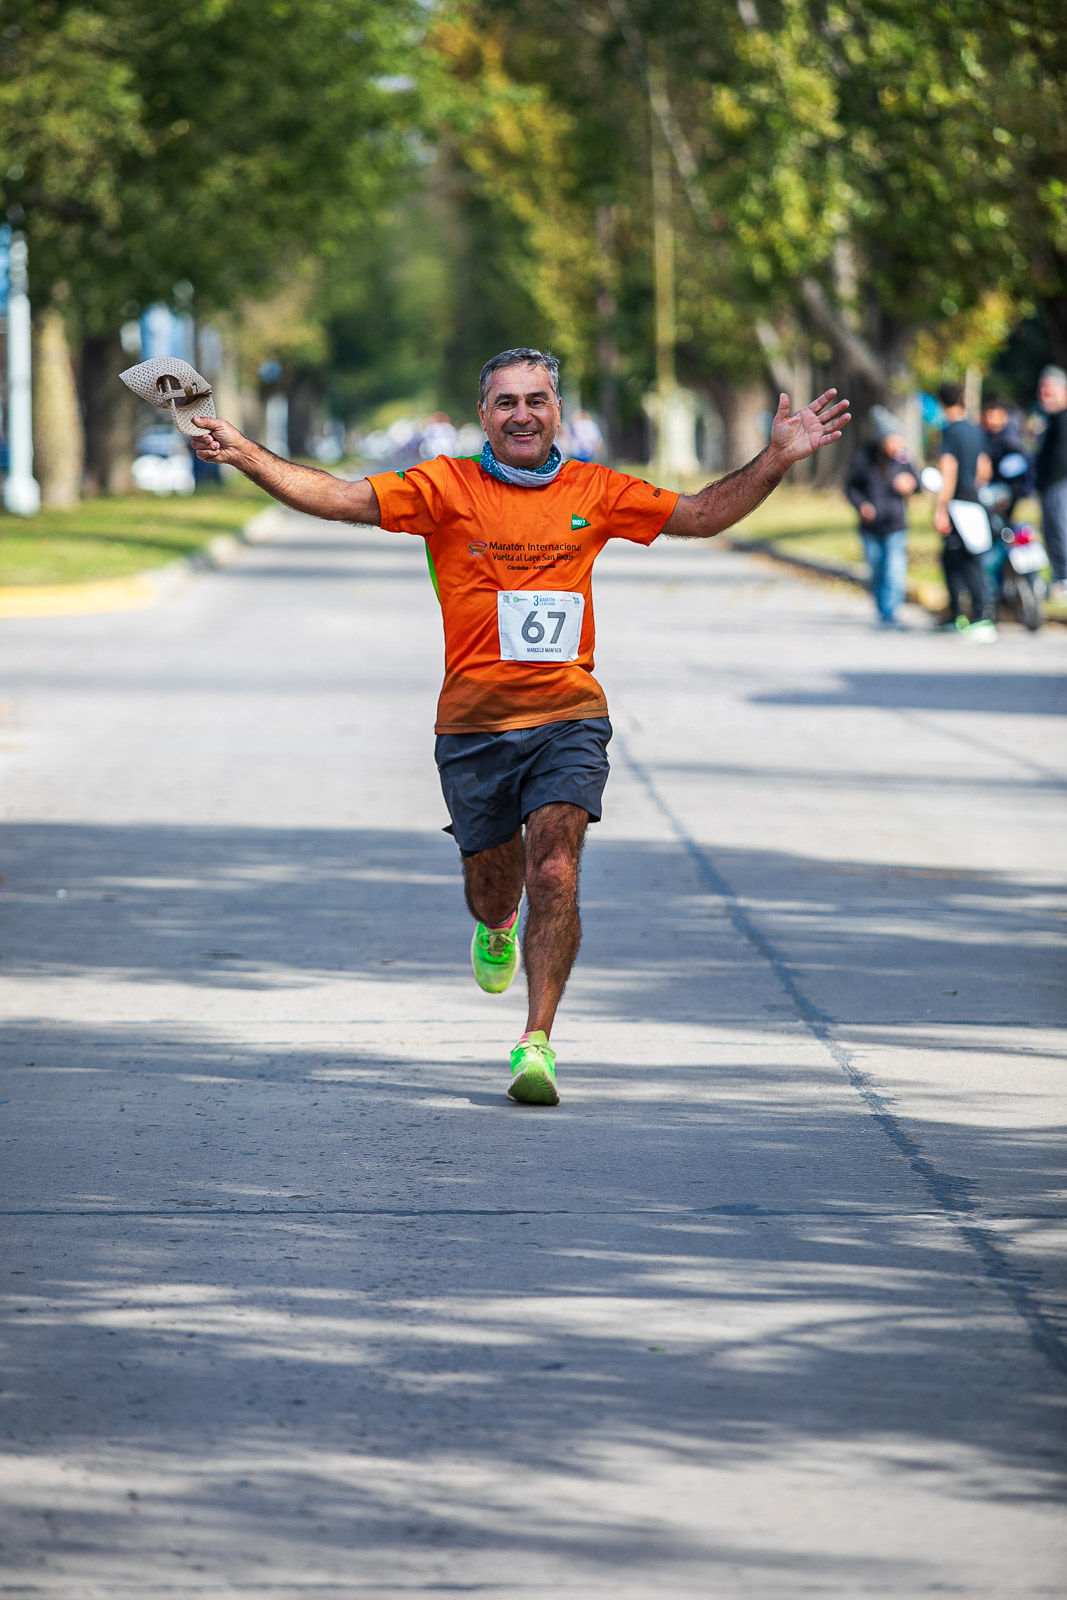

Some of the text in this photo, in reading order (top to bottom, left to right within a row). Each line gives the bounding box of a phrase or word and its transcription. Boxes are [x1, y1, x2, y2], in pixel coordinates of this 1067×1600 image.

[489, 542, 581, 552] Maratón Internacional
[492, 552, 514, 561] Vuelta
[515, 553, 522, 561] al
[524, 554, 540, 563] Lago
[542, 553, 555, 561] San
[533, 595, 539, 606] 3
[521, 611, 566, 644] 67
